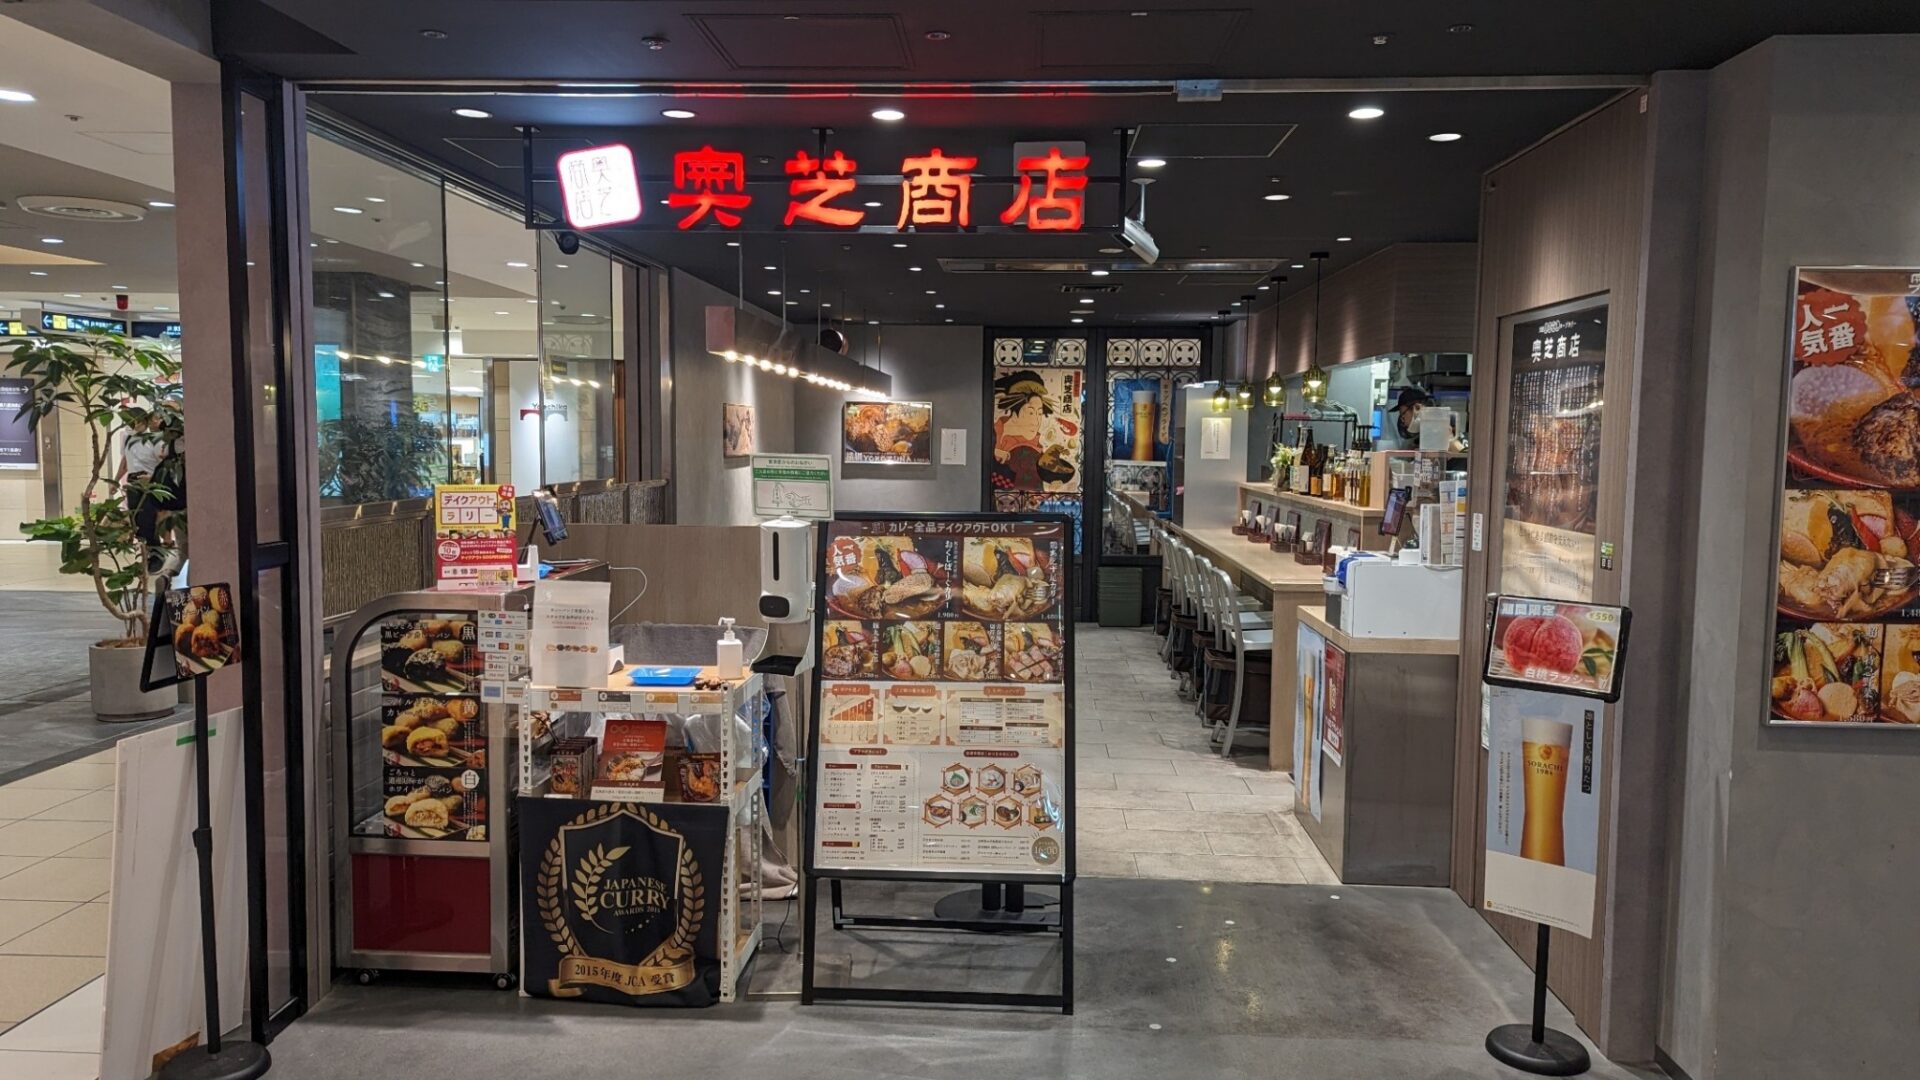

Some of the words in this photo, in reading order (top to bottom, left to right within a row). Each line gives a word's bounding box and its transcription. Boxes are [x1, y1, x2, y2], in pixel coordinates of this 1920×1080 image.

[668, 147, 1091, 229] 奥芝商店
[1531, 333, 1580, 363] 奥芝商店
[444, 495, 493, 505] テイクアウト
[1501, 602, 1556, 616] 期間限定
[1527, 760, 1563, 773] SORACHI
[465, 772, 476, 786] 白
[603, 876, 667, 893] JAPANESE
[600, 889, 670, 910] CURRY
[613, 906, 645, 917] AWARDS
[575, 964, 623, 985] 2015年度
[624, 975, 646, 987] JCA
[651, 972, 675, 986] 受賞
